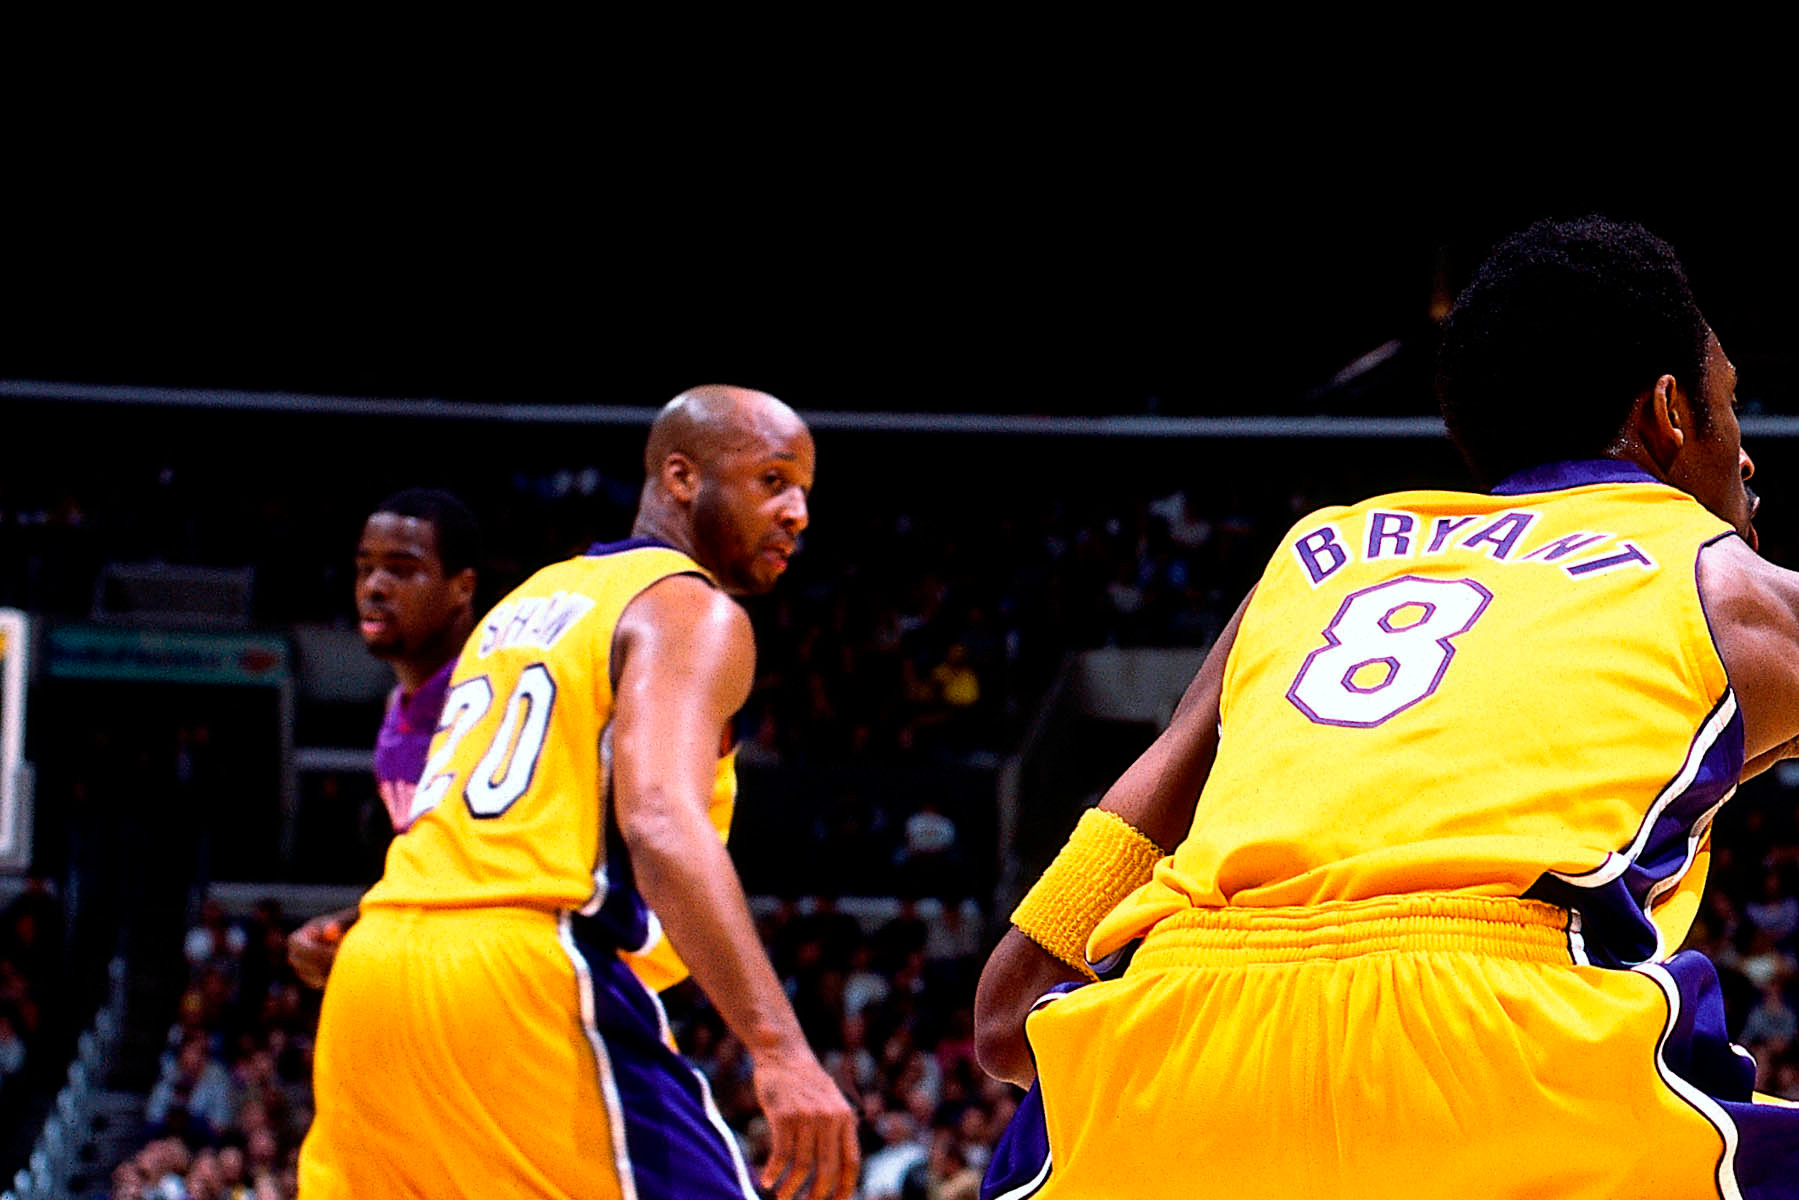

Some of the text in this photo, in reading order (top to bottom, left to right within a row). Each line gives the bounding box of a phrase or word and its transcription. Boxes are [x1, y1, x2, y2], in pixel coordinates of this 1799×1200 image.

[1293, 508, 1658, 590] BRYANT
[1285, 574, 1495, 729] 8
[408, 662, 557, 820] 20
